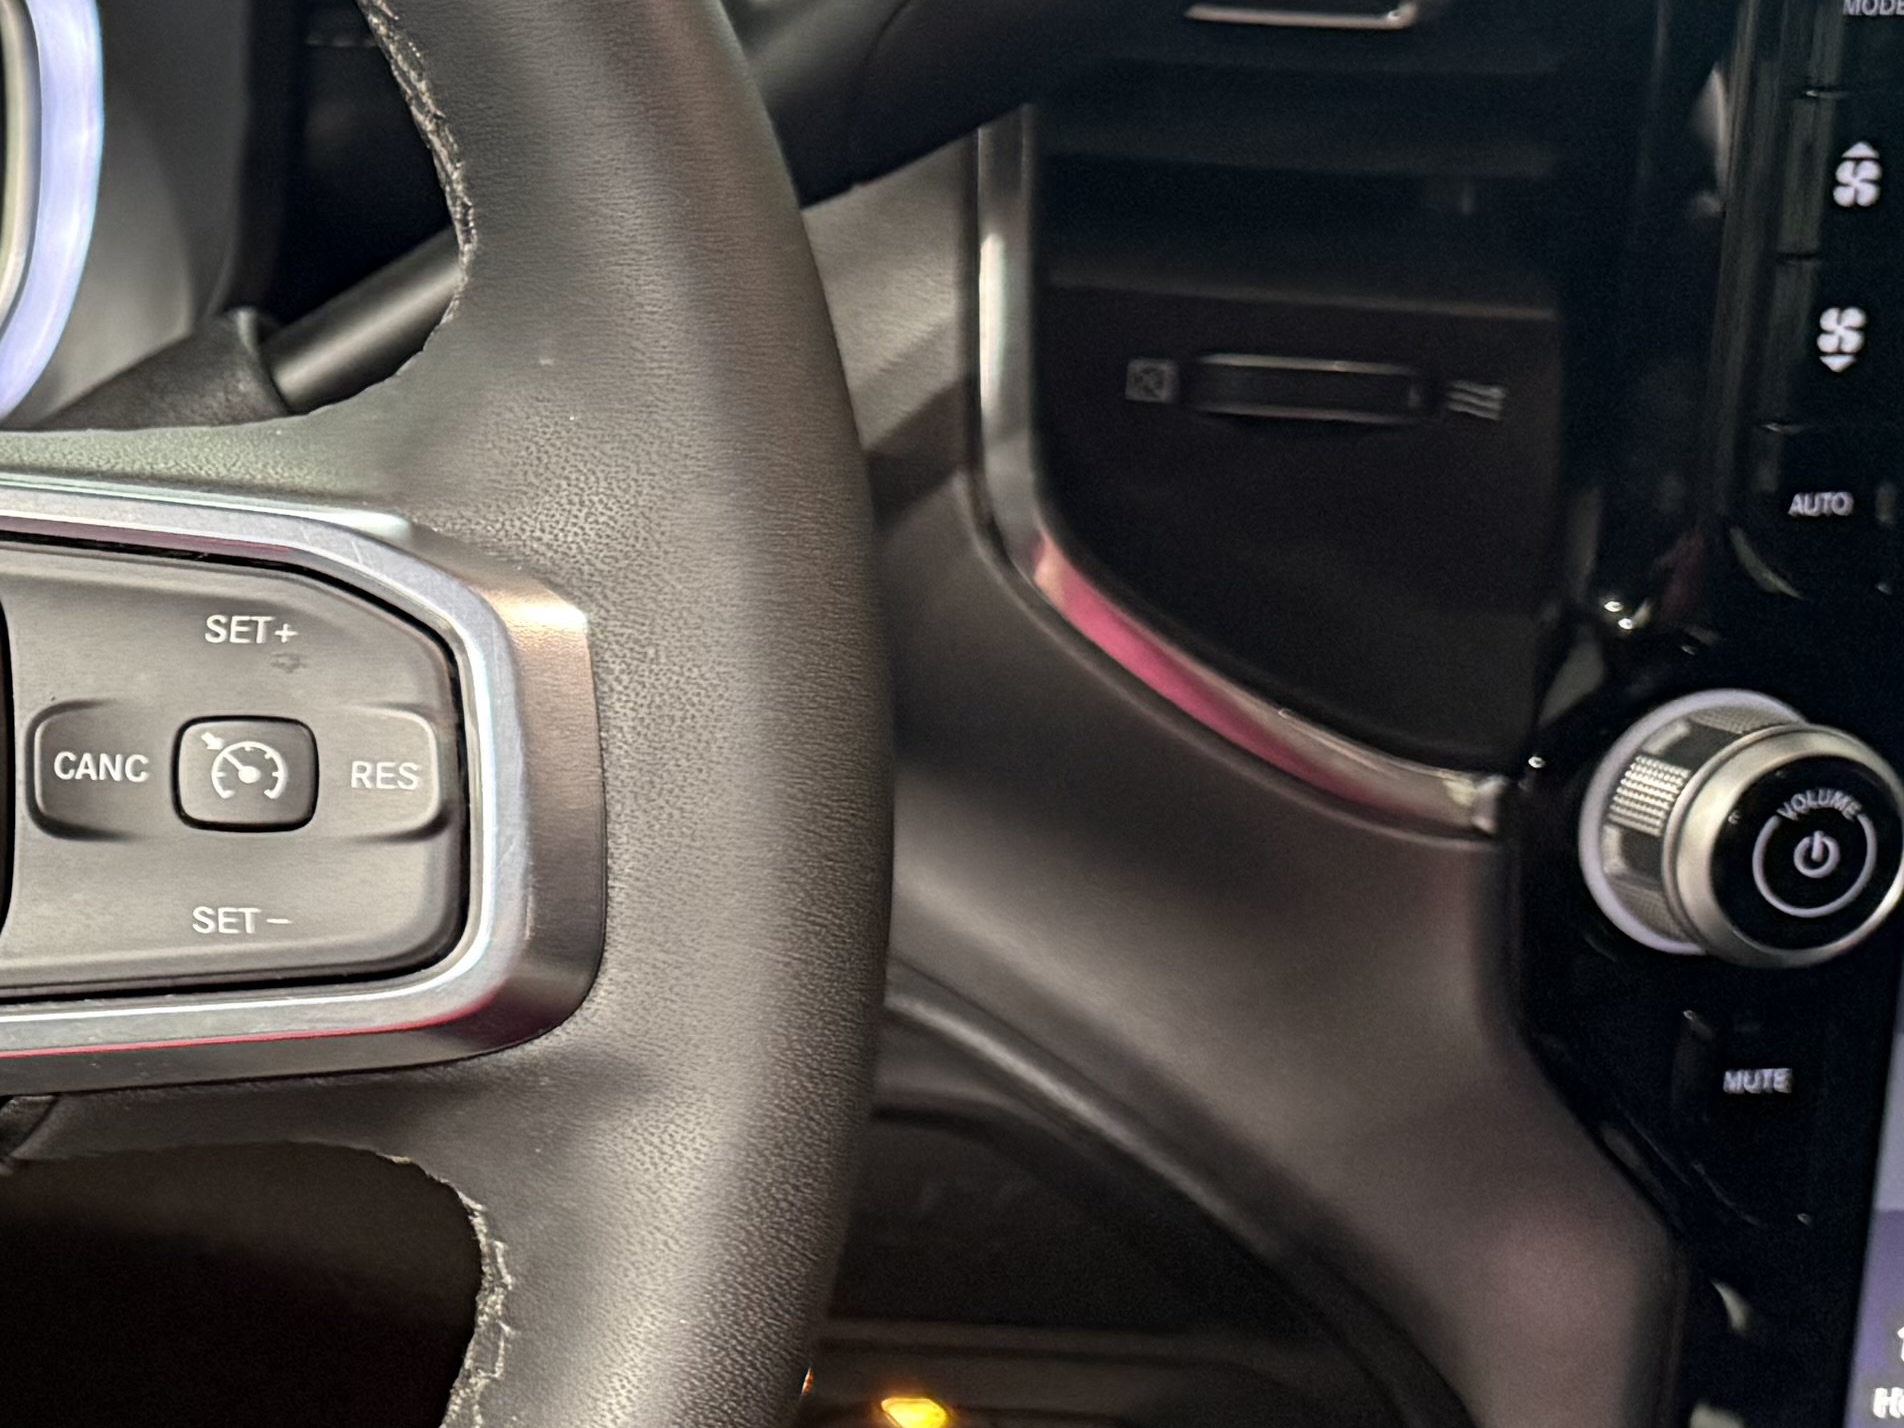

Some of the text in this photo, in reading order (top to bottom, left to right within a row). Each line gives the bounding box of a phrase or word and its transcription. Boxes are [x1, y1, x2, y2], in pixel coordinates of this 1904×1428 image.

[1787, 490, 1854, 517] AUTO
[52, 751, 150, 783] CANC
[349, 761, 420, 791] RES
[1775, 788, 1863, 822] VOLUME
[1722, 1067, 1793, 1095] MUTE
